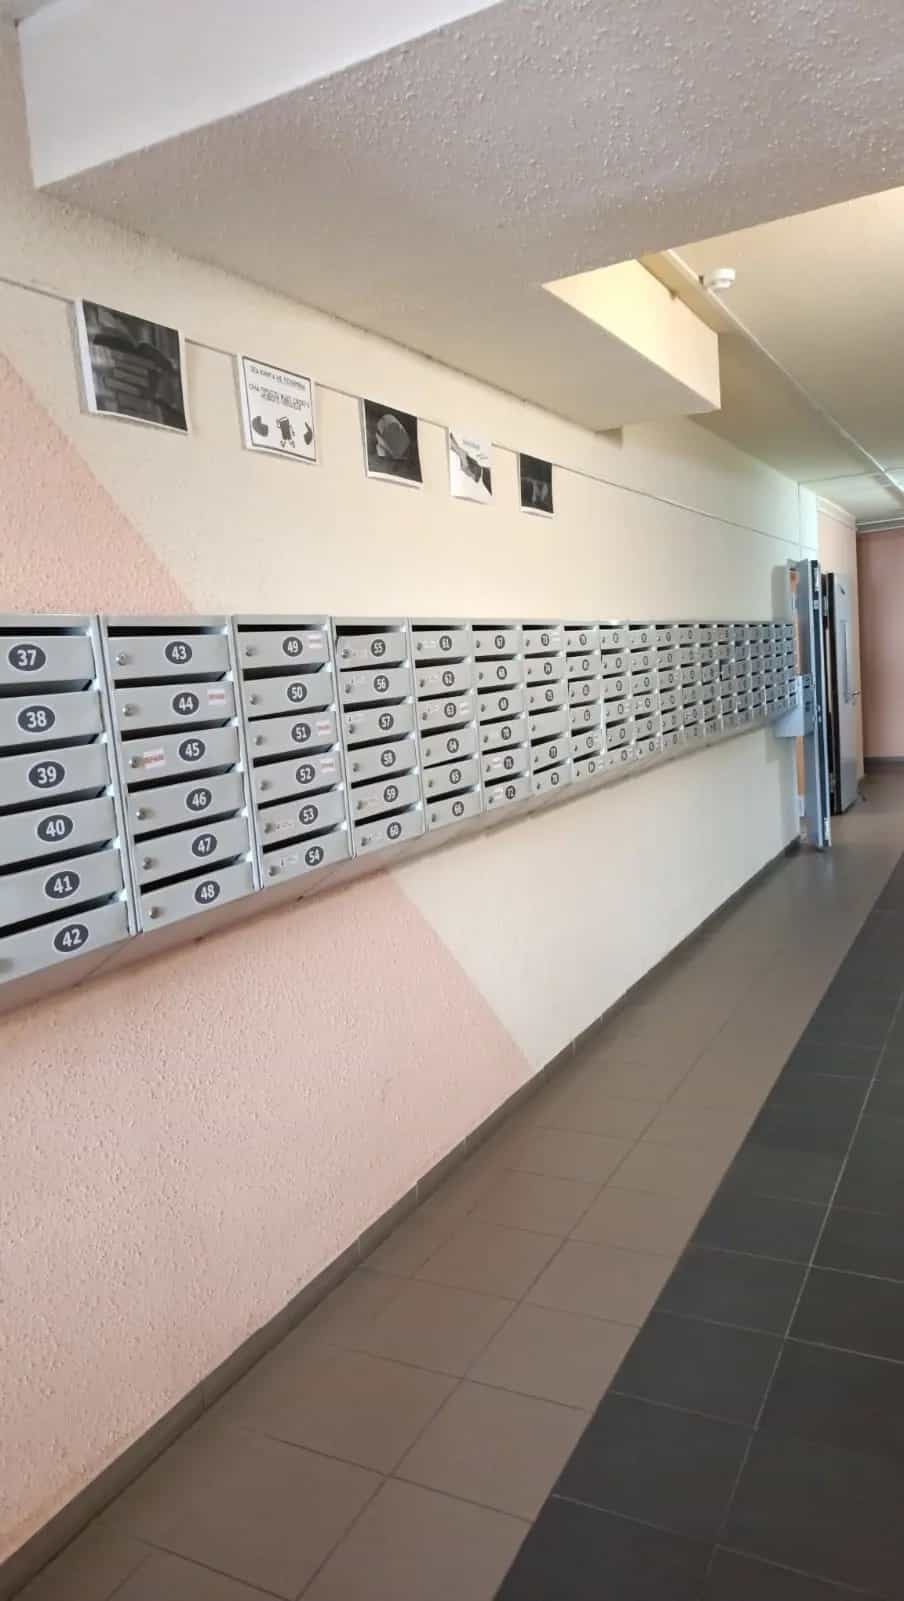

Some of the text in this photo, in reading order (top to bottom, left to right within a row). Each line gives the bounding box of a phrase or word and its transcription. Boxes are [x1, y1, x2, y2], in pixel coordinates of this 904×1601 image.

[172, 645, 187, 660] 43
[287, 640, 299, 653] 49
[374, 642, 383, 654] 55
[17, 649, 37, 666] 37
[377, 678, 386, 690] 56
[291, 686, 303, 699] 50
[179, 696, 193, 710] 44
[26, 710, 47, 728] 38
[381, 715, 390, 728] 57
[296, 727, 307, 739] 51
[185, 742, 200, 757] 45
[37, 766, 57, 784] 39
[300, 767, 312, 781] 52
[192, 792, 207, 806] 46
[387, 788, 396, 800] 59
[303, 808, 314, 821] 53
[46, 819, 65, 837] 40
[198, 837, 211, 852] 47
[309, 849, 320, 863] 54
[54, 876, 73, 893] 41
[201, 884, 215, 899] 48
[62, 928, 82, 947] 42
